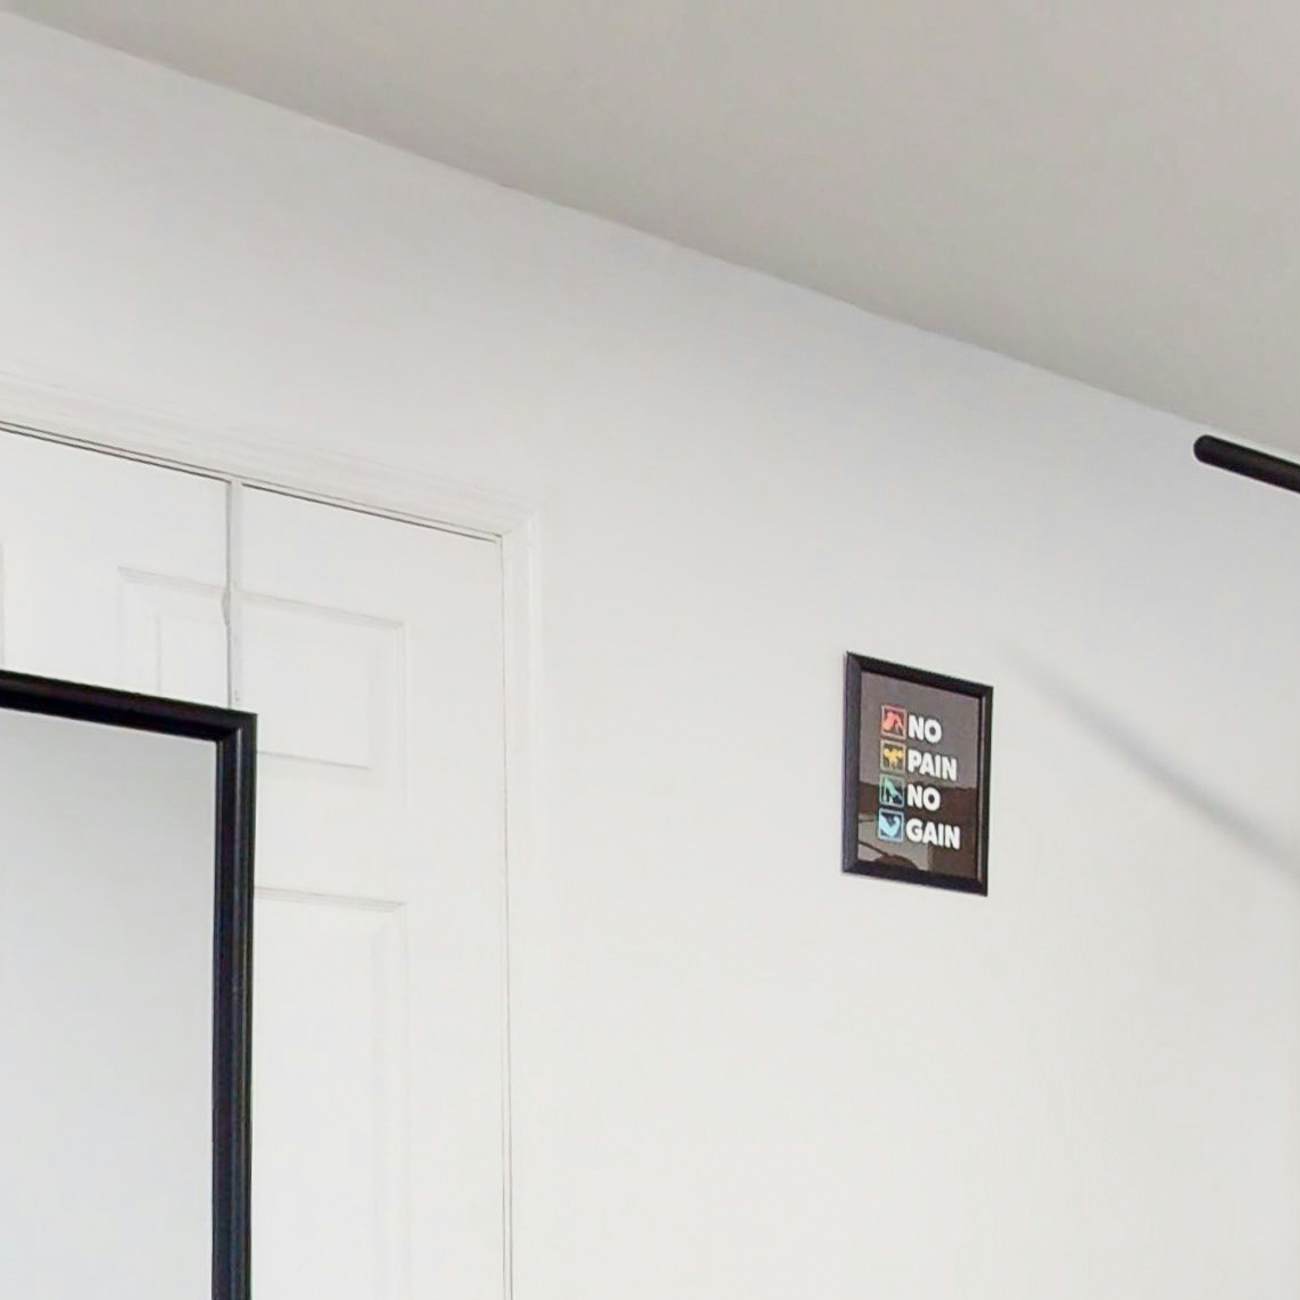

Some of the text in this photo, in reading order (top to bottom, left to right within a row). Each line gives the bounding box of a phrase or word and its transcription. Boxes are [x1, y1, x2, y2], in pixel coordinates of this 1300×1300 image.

[908, 714, 942, 744] NO
[908, 749, 958, 782] PAIN
[907, 783, 941, 812] NO
[906, 818, 961, 850] GAIN
